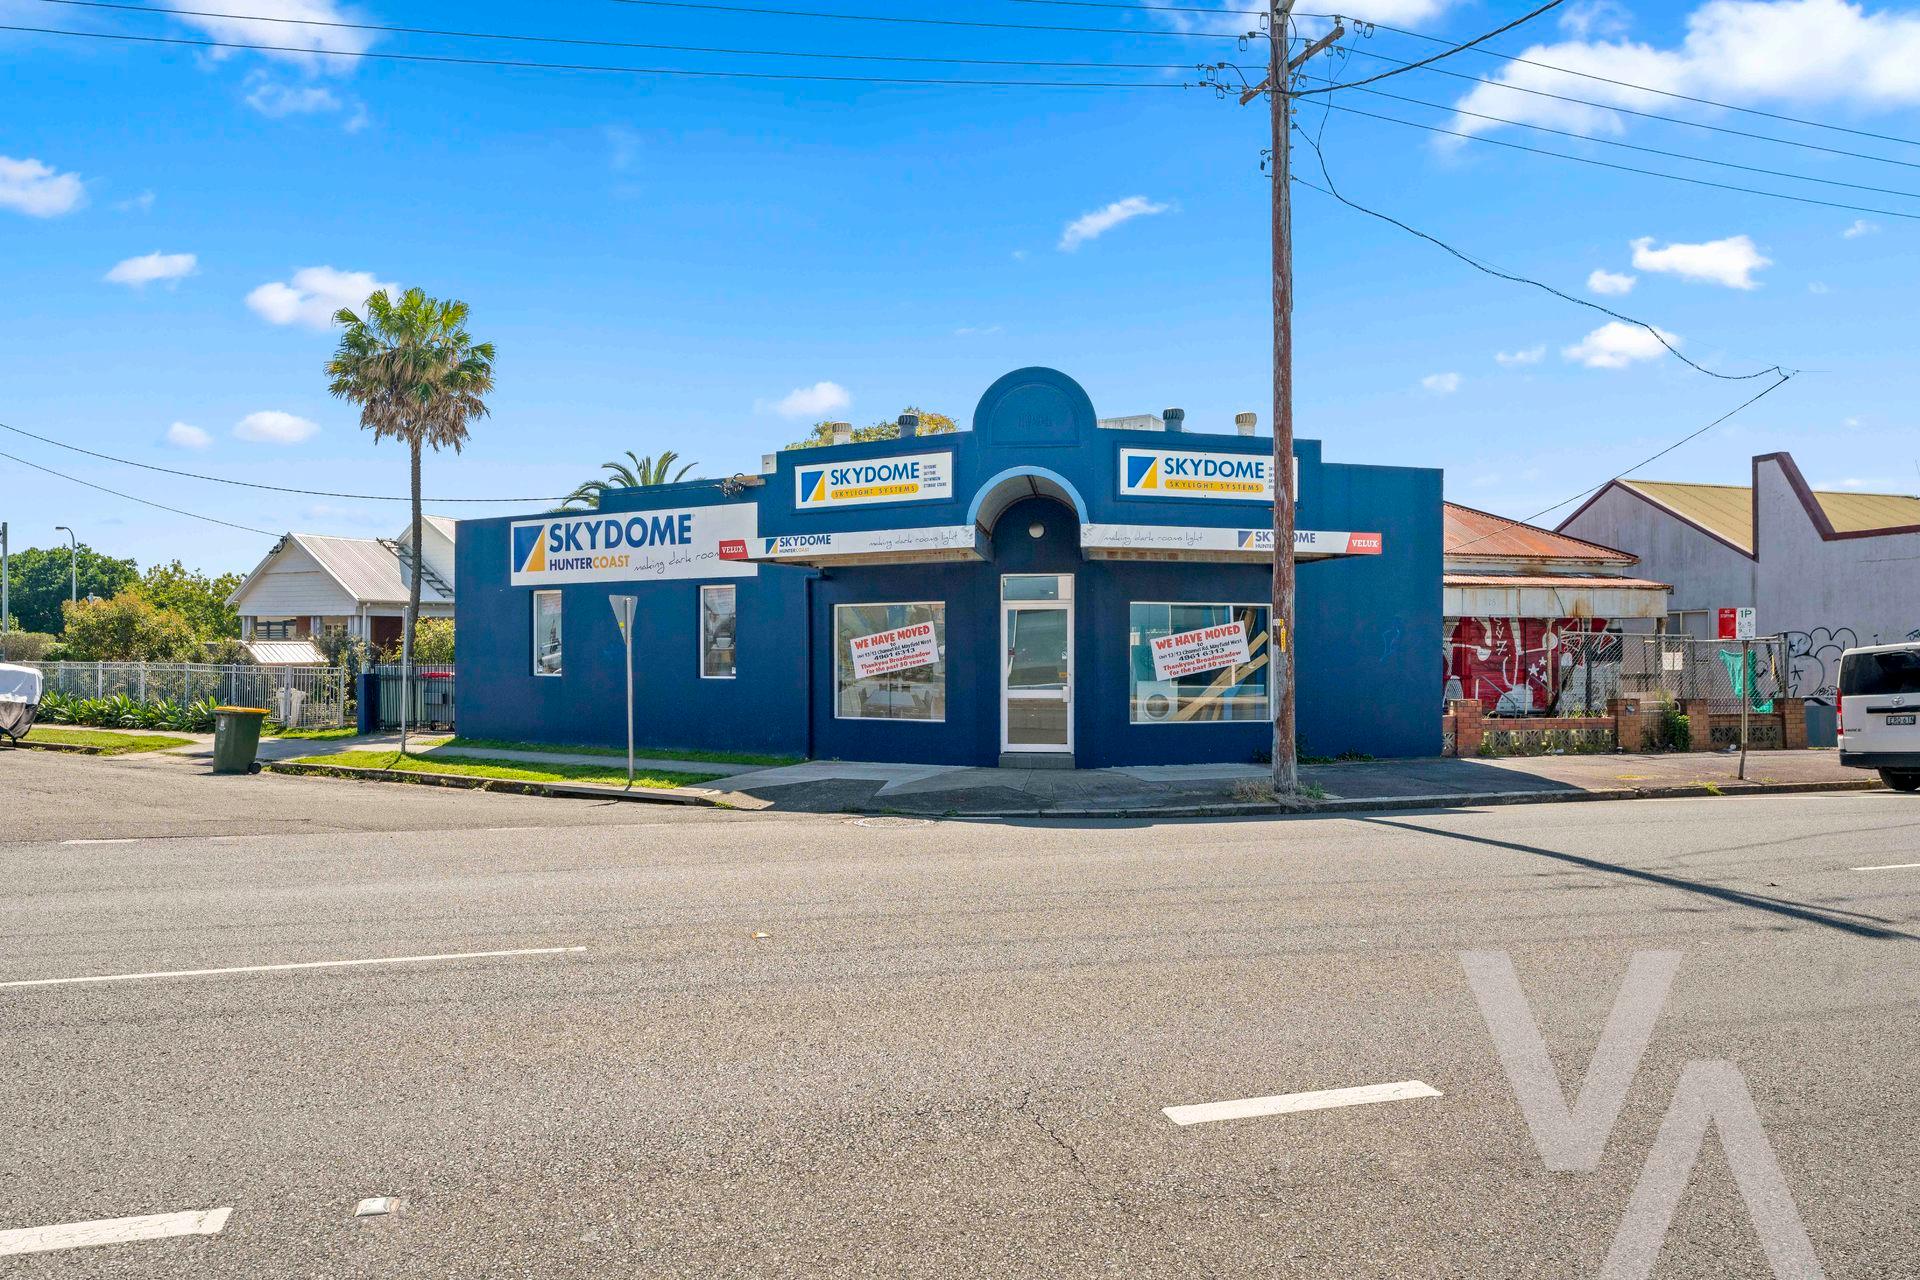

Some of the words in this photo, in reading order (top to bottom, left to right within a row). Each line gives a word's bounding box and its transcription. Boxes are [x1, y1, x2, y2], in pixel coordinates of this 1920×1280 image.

[831, 462, 919, 485] SKYDOME
[1164, 457, 1264, 478] SKYDOME
[835, 488, 874, 498] SKYLIGHT
[880, 485, 915, 494] SYSTEMS
[1170, 481, 1214, 489] SKYLIGHT
[1220, 483, 1260, 491] SYSTEMS
[549, 514, 692, 553] SKYDOME
[779, 534, 832, 547] SKYDOME
[869, 537, 893, 549] making
[895, 533, 912, 545] dark
[941, 530, 958, 546] light
[1103, 530, 1131, 546] making
[1134, 531, 1154, 542] dark
[1185, 531, 1204, 546] light
[721, 545, 743, 554] VELUX
[1352, 539, 1378, 548] VELUX
[549, 555, 630, 571] HUNTERCOAST
[633, 556, 665, 575] making
[668, 548, 692, 566] dark
[854, 639, 869, 650] WE
[871, 632, 895, 647] HAVE
[897, 624, 930, 640] MOVED
[1155, 638, 1173, 650] WE
[1175, 632, 1203, 647] HAVE
[1205, 624, 1241, 640] MOVED
[860, 659, 888, 670] Thankyou
[889, 650, 931, 664] Broadmeadow
[1202, 647, 1225, 657] 6313
[886, 662, 899, 671] past
[1162, 659, 1195, 671] Thankyou
[1196, 650, 1242, 664] Broadmeadow
[1169, 668, 1179, 676] for
[1180, 665, 1191, 673] the
[1192, 663, 1207, 672] past
